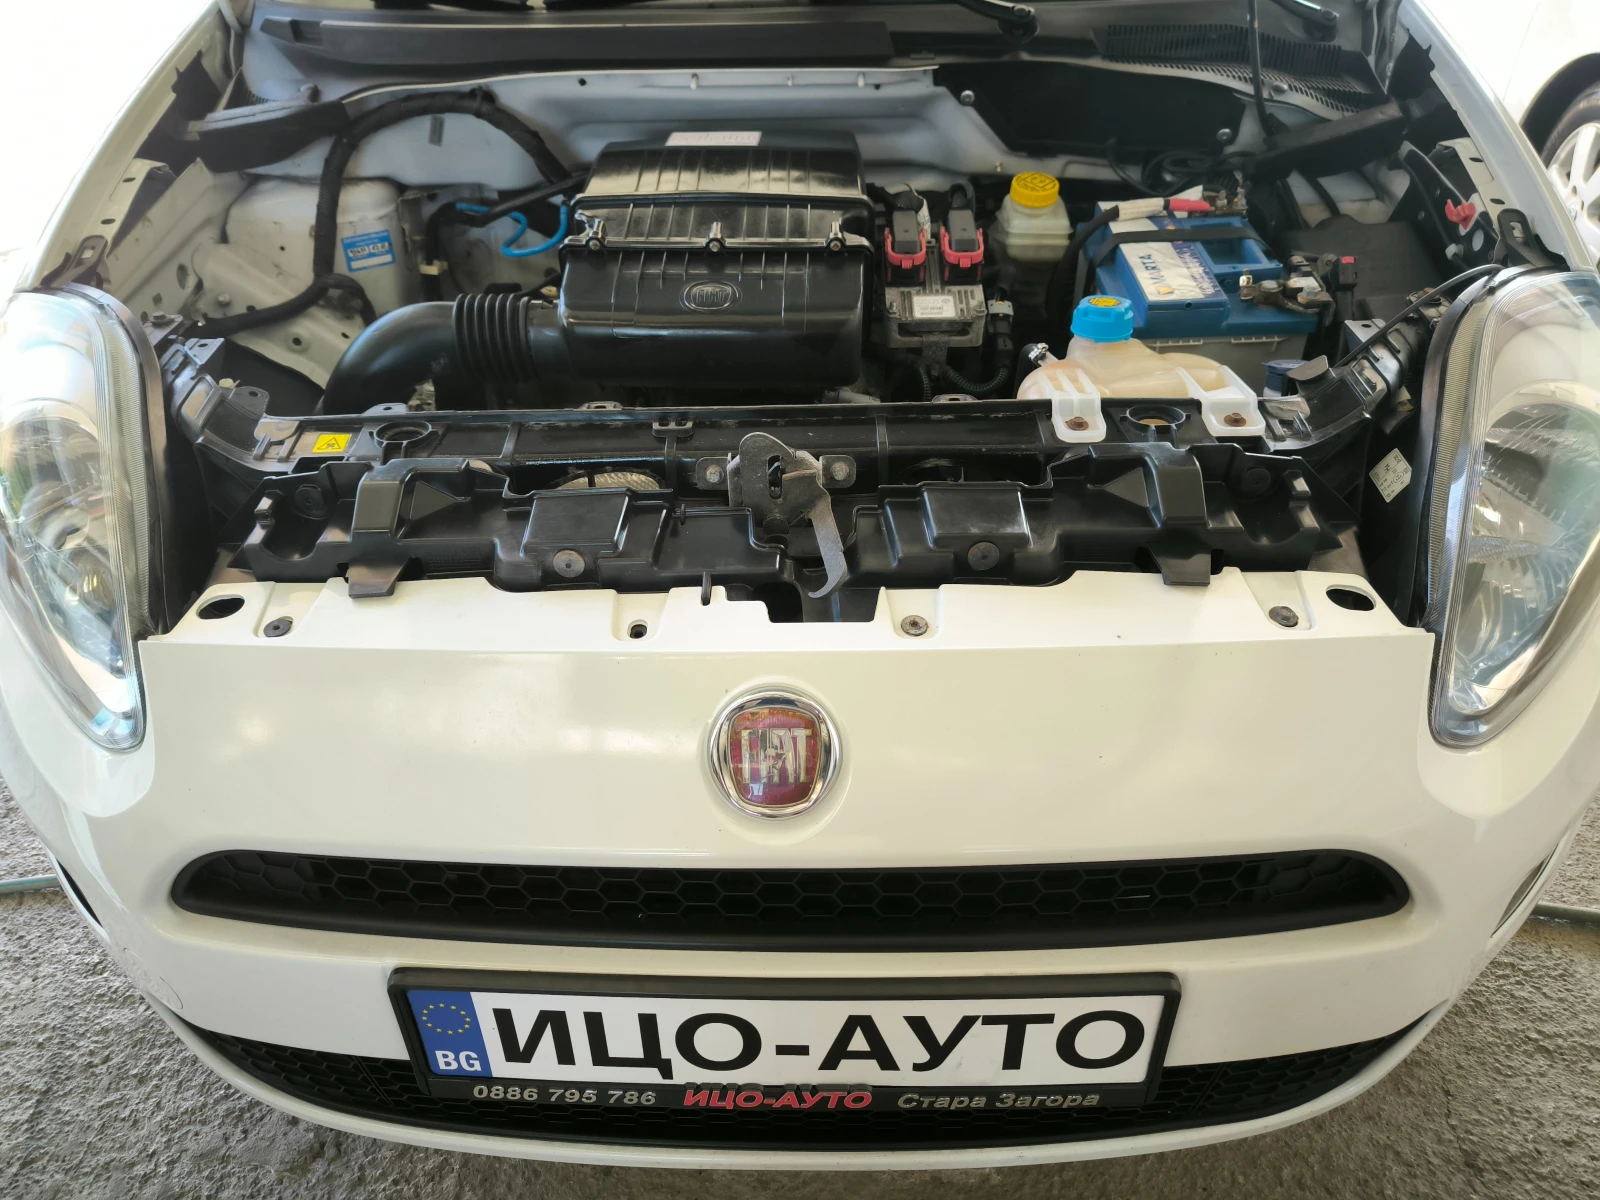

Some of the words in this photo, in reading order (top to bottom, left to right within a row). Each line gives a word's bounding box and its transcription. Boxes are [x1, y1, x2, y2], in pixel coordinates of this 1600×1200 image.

[1138, 253, 1167, 286] VARTA
[741, 727, 813, 784] FIAT
[492, 1008, 1145, 1080] ИЦО-АУТО
[434, 1050, 482, 1072] BG
[473, 1085, 538, 1101] 0886
[548, 1089, 597, 1103] 795
[607, 1090, 656, 1105] 786
[683, 1089, 873, 1110] ИЦО-АУТО
[897, 1093, 986, 1110] Стара
[995, 1092, 1099, 1108] Загора
